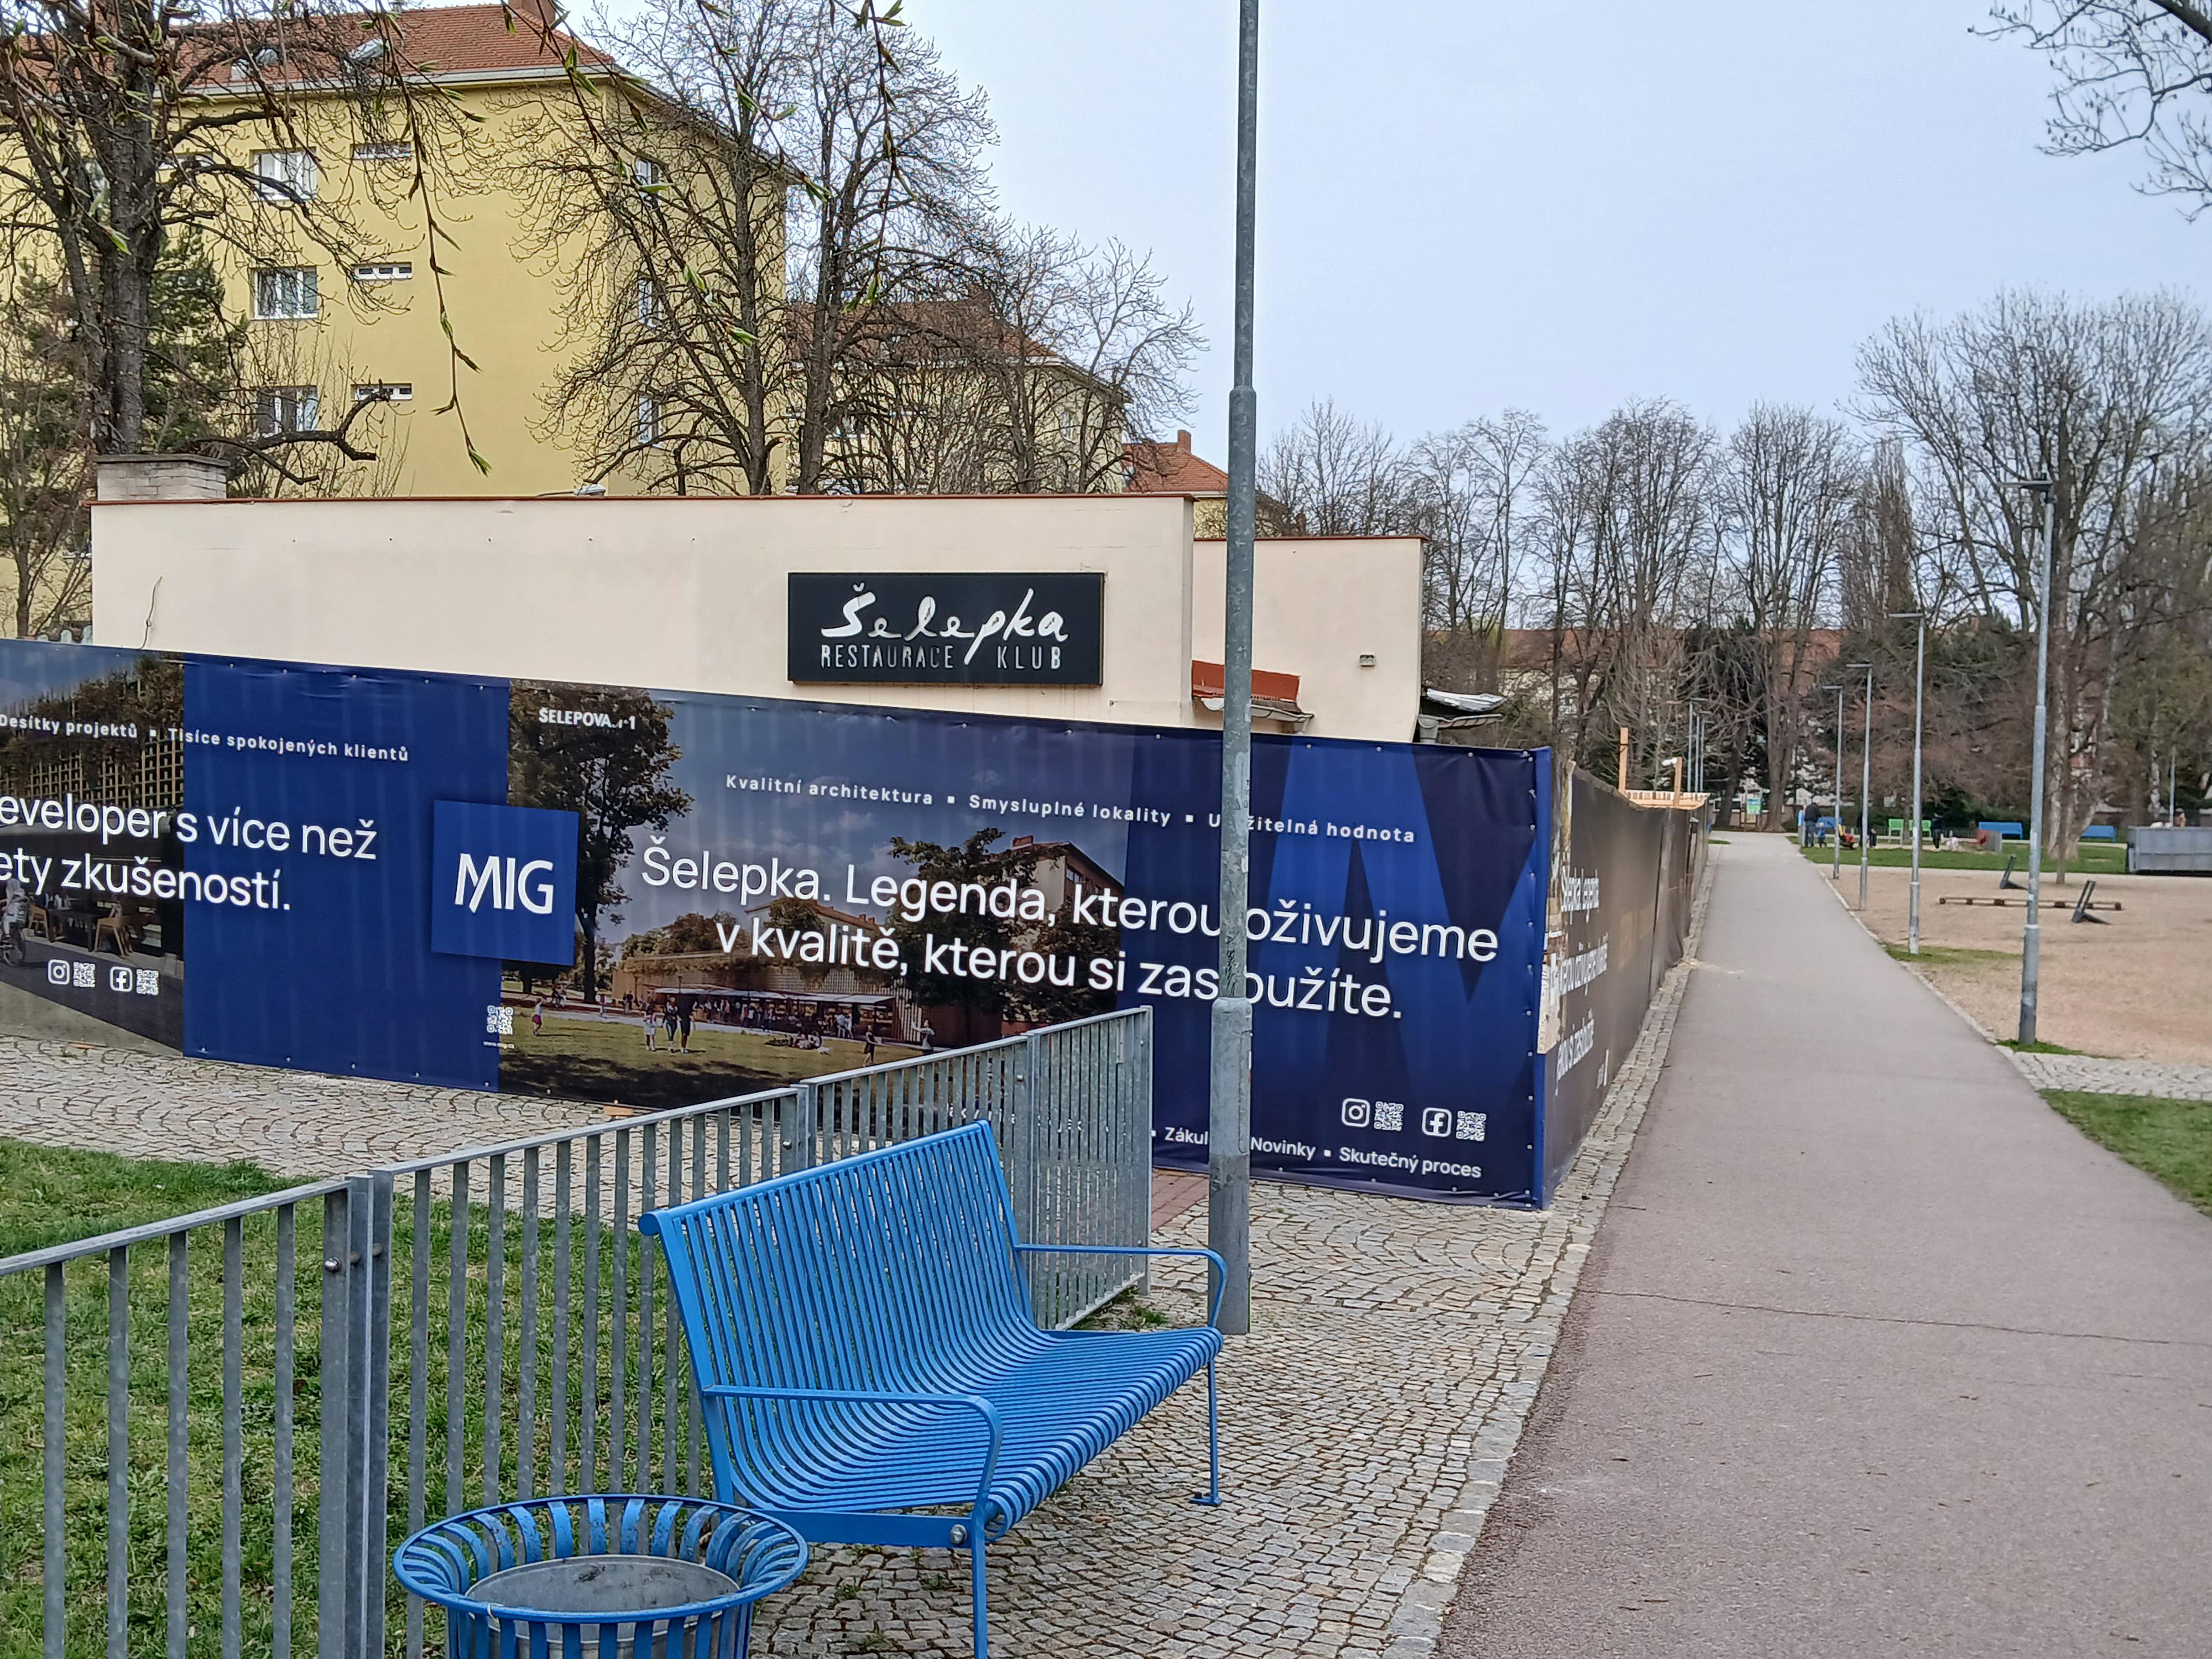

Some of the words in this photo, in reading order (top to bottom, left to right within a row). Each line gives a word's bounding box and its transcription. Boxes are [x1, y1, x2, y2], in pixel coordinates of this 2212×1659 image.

[821, 582, 1069, 665] Šelepka
[821, 644, 954, 669] RESTAURACE
[997, 645, 1062, 669] KLUB
[66, 722, 138, 739] projektů
[168, 727, 221, 745] Tisíce
[227, 733, 337, 757] spokojených
[344, 743, 409, 761] klientů
[539, 707, 612, 728] ŠELEPOVA
[0, 792, 168, 846] eveloper
[176, 812, 198, 843] s
[207, 806, 290, 851] více
[302, 818, 377, 860] než
[726, 774, 802, 794] Kvalitní
[808, 783, 933, 805] architektura
[969, 794, 1086, 818] Smysluplné
[1092, 804, 1171, 827] lokality
[1208, 812, 1318, 836] Užitelná
[1326, 822, 1415, 843] hodnota
[0, 847, 53, 896] ety
[60, 853, 290, 911] zkušeností.
[454, 853, 554, 914] MIG
[641, 834, 831, 906] Šelepka.
[846, 863, 1056, 927] Legenda,
[1245, 898, 1499, 964] oživujeme
[716, 922, 741, 953] v
[751, 917, 909, 977] kvalitě,
[924, 933, 1076, 987] kterou
[1088, 951, 1126, 992] si
[1138, 961, 1402, 1019] zasoužíte.
[1250, 1136, 1317, 1161] Novinky
[1339, 1146, 1420, 1171] Skutečný
[1421, 1158, 1482, 1178] proces
